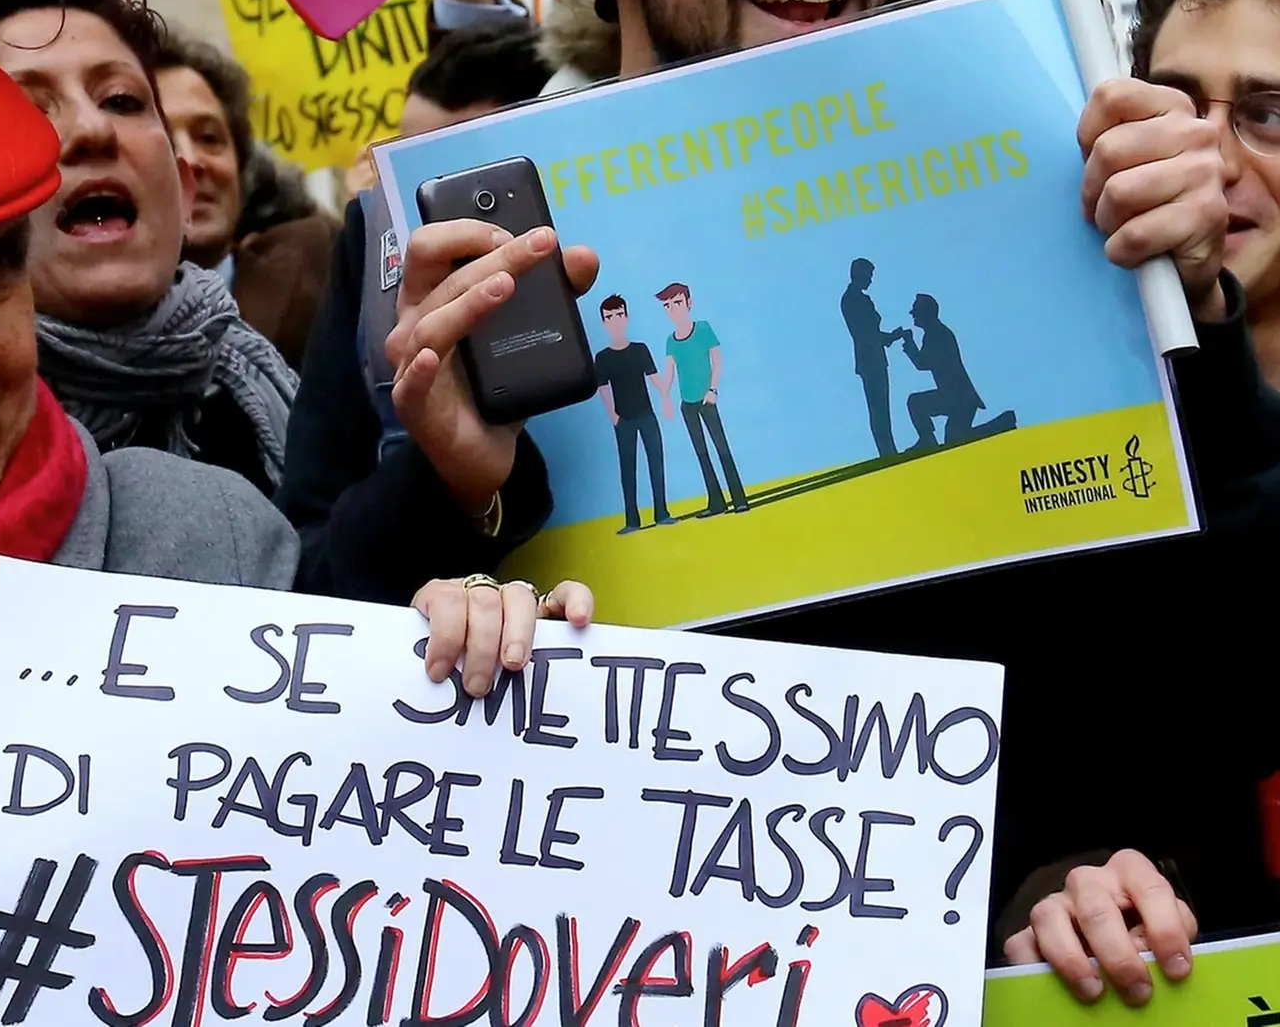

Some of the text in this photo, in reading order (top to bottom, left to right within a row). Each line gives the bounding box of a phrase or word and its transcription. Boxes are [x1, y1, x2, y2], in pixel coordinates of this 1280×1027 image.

[543, 81, 896, 209] FFERENTPEOPLE
[741, 129, 1031, 240] #SAMERIGHTS
[1020, 454, 1110, 494] AMNESTY
[1024, 483, 1117, 514] INTERNATIONAL
[222, 622, 355, 716] SE
[1, 742, 91, 816] DI
[166, 740, 482, 859] PAGARE
[498, 777, 605, 870] LE
